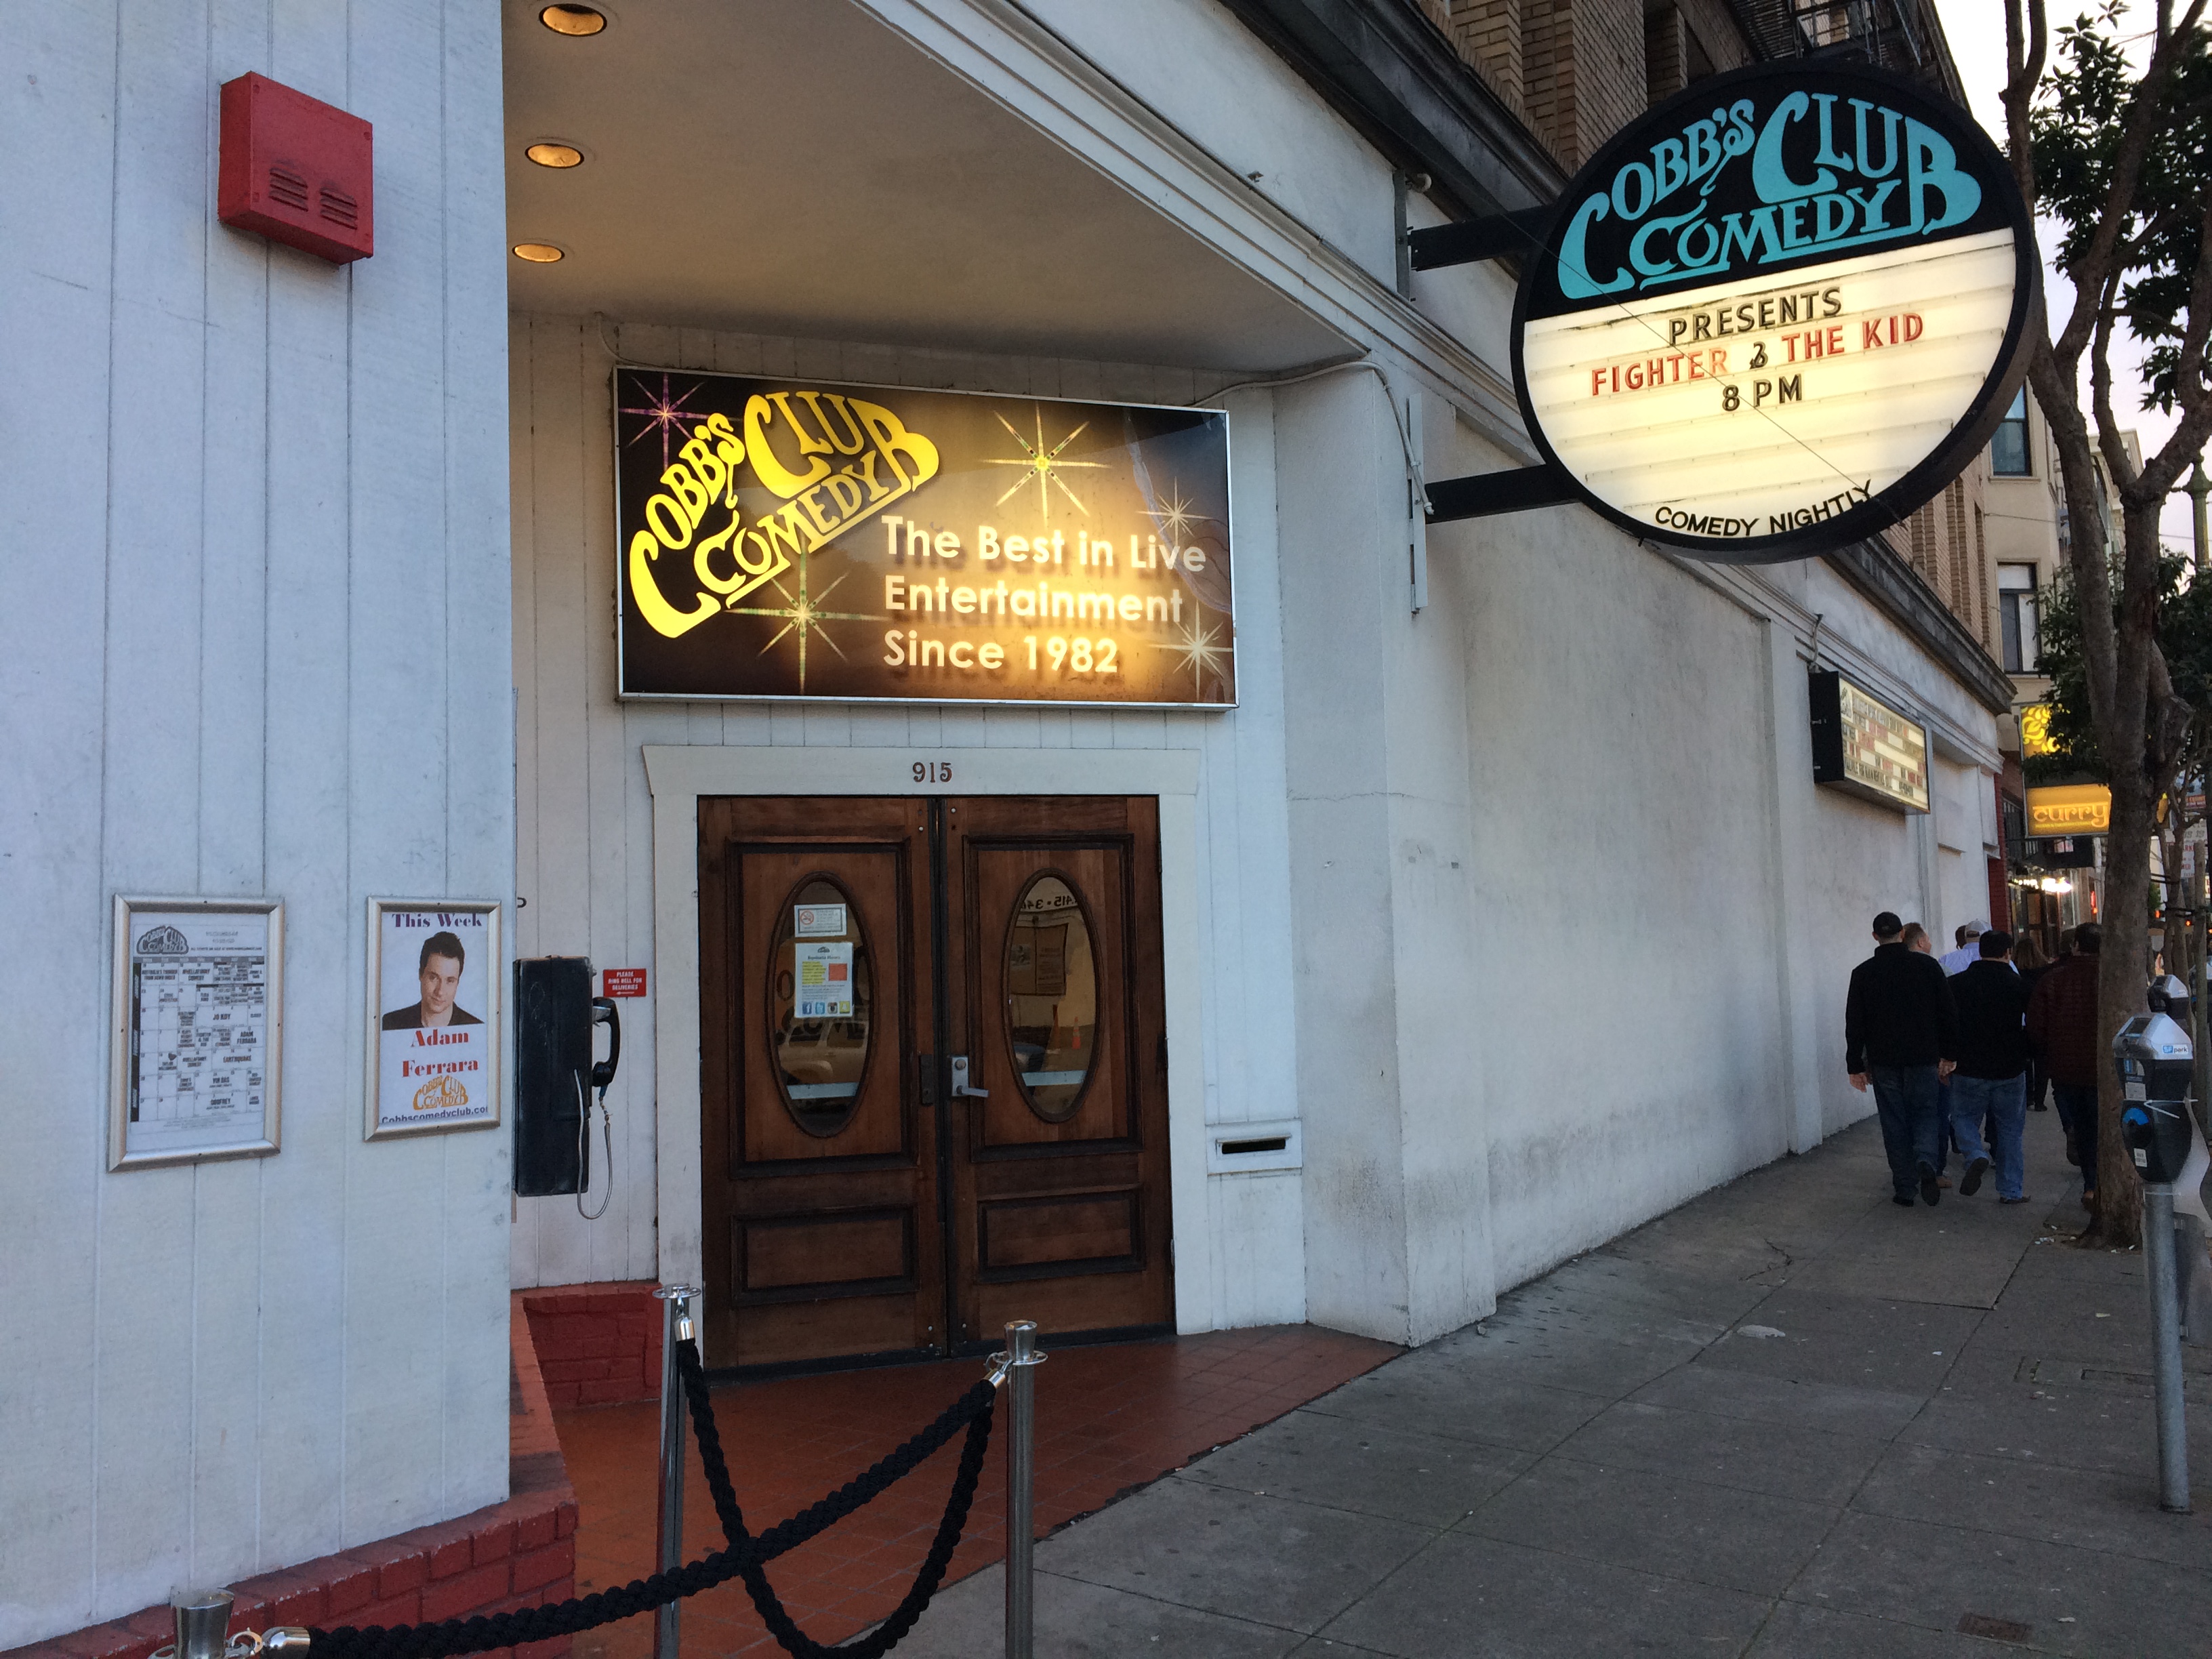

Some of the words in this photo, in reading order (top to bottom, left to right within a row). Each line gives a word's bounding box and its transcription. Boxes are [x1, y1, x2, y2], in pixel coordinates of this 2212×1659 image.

[1752, 91, 1982, 235] CLUB
[1557, 98, 1755, 300] COBB'S
[1629, 178, 1912, 290] COMEDY
[1669, 286, 1843, 346] PRESENTS
[1591, 348, 1728, 396] FIGHTER
[1781, 325, 1844, 363] THE
[1862, 312, 1924, 350] KID
[1722, 384, 1740, 412] 8
[1753, 373, 1803, 407] PM
[743, 390, 940, 500] CLUB
[628, 411, 747, 638] COBB'S
[693, 449, 901, 609] COMEDY
[1654, 505, 1759, 537] COMEDY
[1769, 479, 1872, 535] NIGHTLY
[881, 515, 961, 558] The
[978, 525, 1064, 565] Best
[1078, 530, 1114, 567] in
[1130, 534, 1206, 573] Live
[884, 575, 1183, 623] Entertainment
[883, 628, 1005, 670] Since
[1025, 635, 1120, 674] 1982
[912, 762, 952, 783] 915
[2032, 802, 2109, 827] curry
[392, 913, 431, 928] This
[437, 913, 483, 928] Week
[411, 1029, 470, 1048] Adam
[401, 1059, 479, 1078] Ferrara
